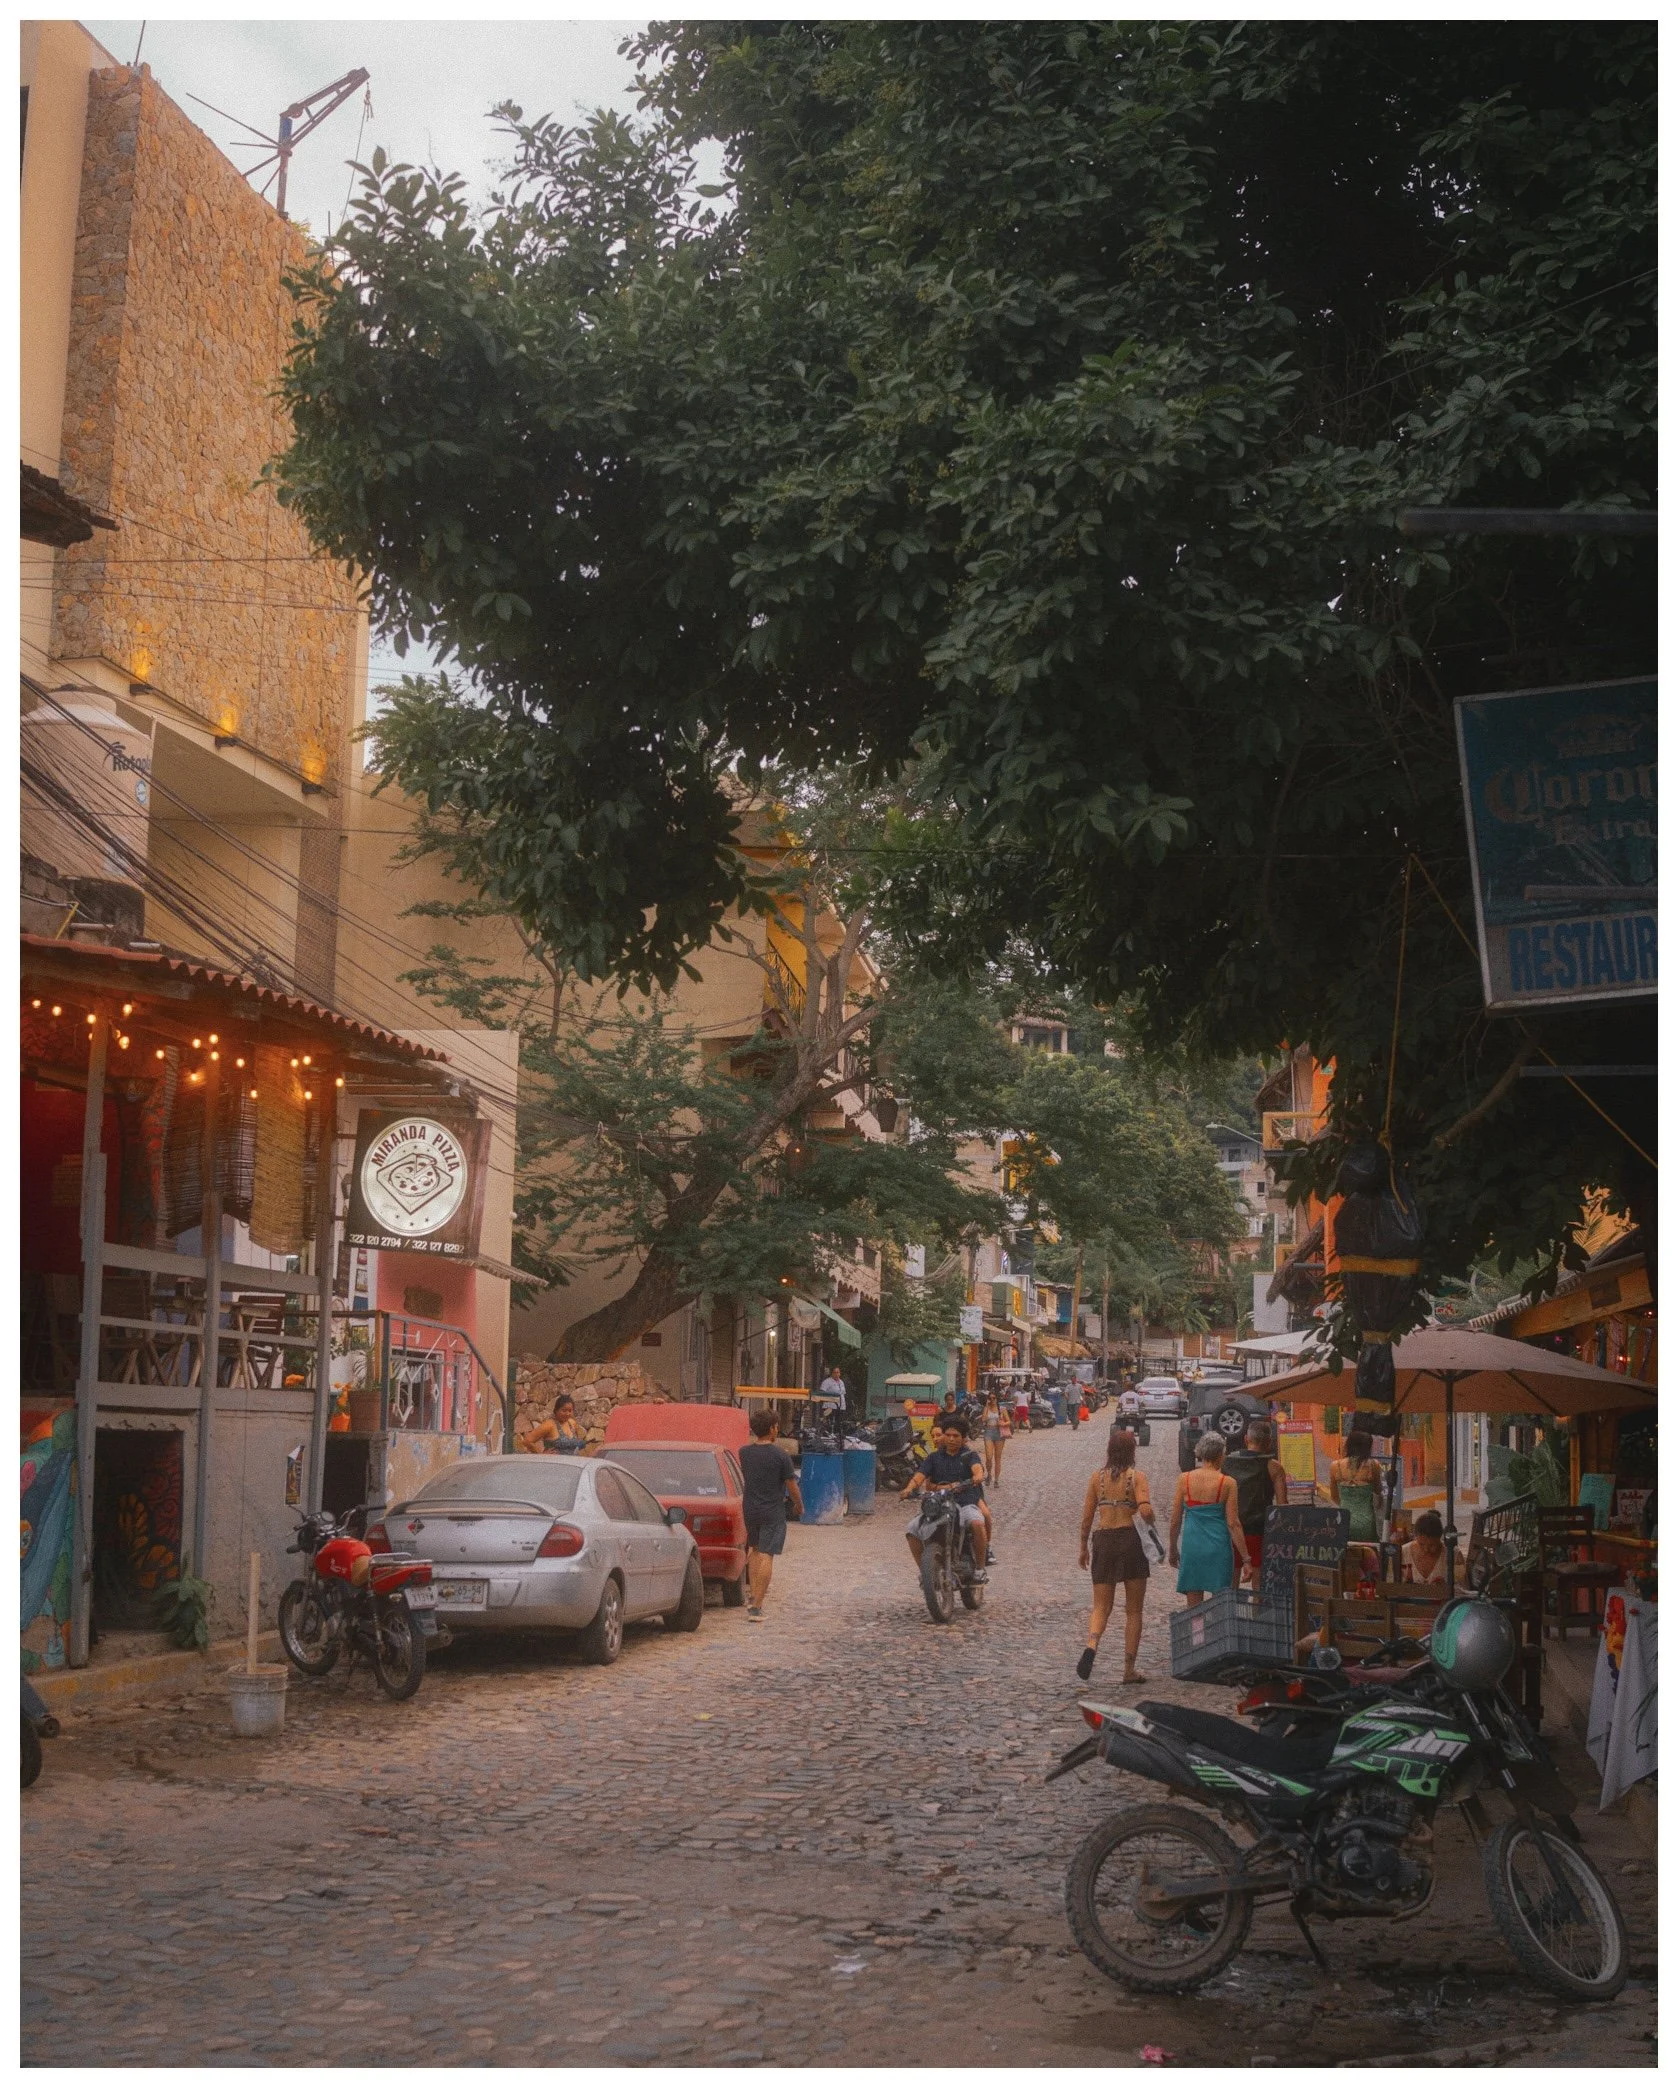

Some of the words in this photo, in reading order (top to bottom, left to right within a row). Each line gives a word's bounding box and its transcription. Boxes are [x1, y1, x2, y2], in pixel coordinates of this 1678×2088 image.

[371, 1125, 427, 1167] MIRANDA
[432, 1133, 460, 1173] PIZZA
[349, 1233, 364, 1244] 322
[366, 1235, 379, 1245] 120
[380, 1236, 401, 1248] 2794
[412, 1240, 427, 1250] 322
[429, 1241, 442, 1251] 127
[1295, 1545, 1316, 1560] ALL
[1318, 1546, 1345, 1561] DAY
